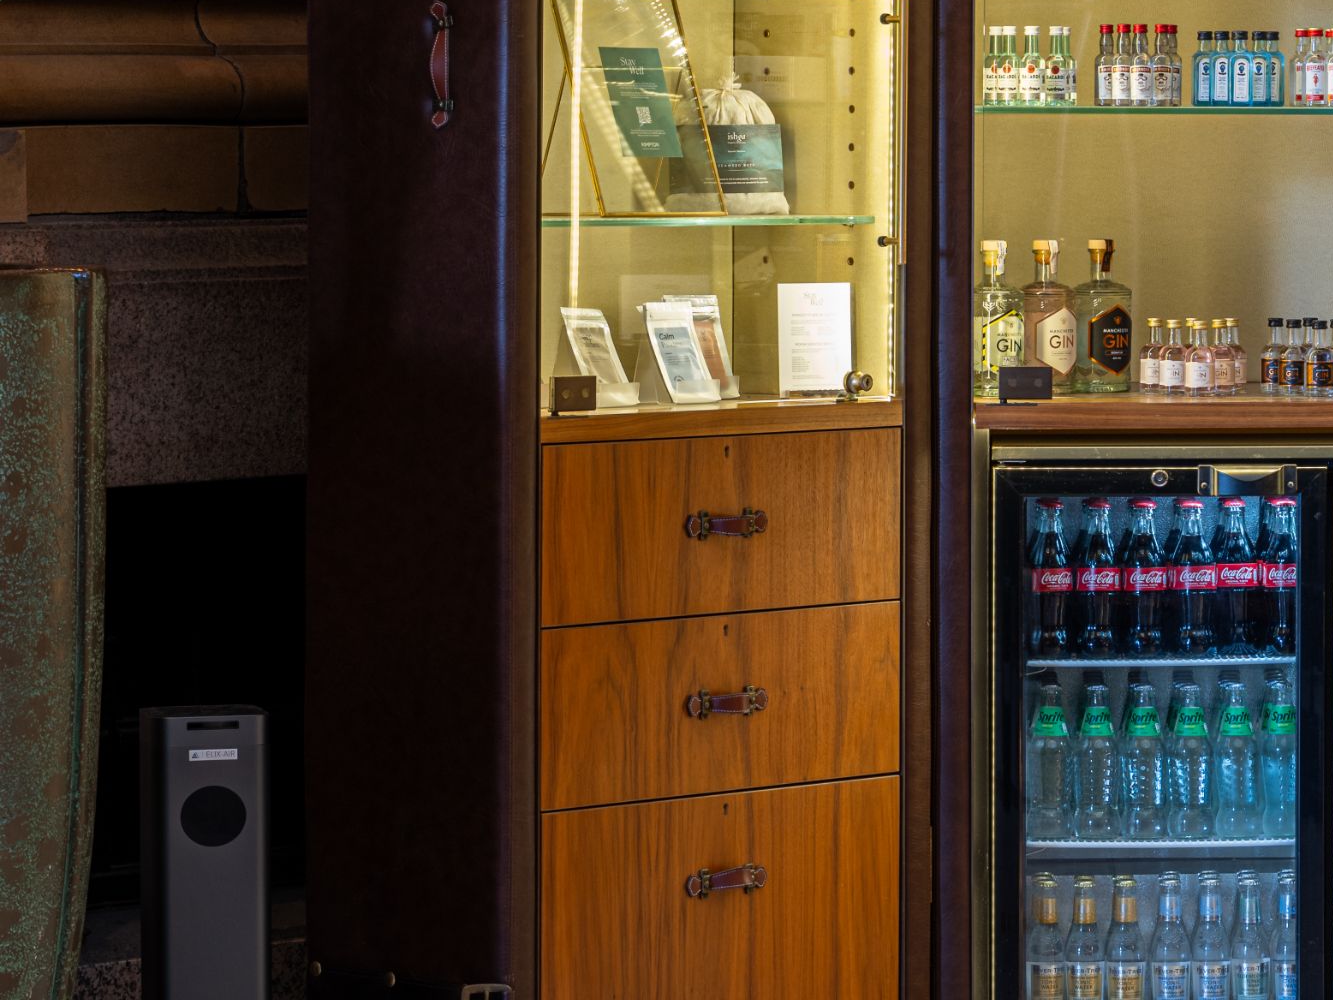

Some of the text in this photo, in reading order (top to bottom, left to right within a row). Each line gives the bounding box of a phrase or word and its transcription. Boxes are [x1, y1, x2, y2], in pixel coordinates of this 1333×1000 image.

[996, 338, 1022, 353] GIN
[1049, 334, 1074, 349] GIN
[1103, 334, 1129, 349] GIN
[1082, 572, 1114, 585] Coca-Cola
[1130, 572, 1163, 585] Coca-Cola
[1179, 570, 1213, 583] Coca-Cola
[1220, 568, 1253, 580] Coca-Cola
